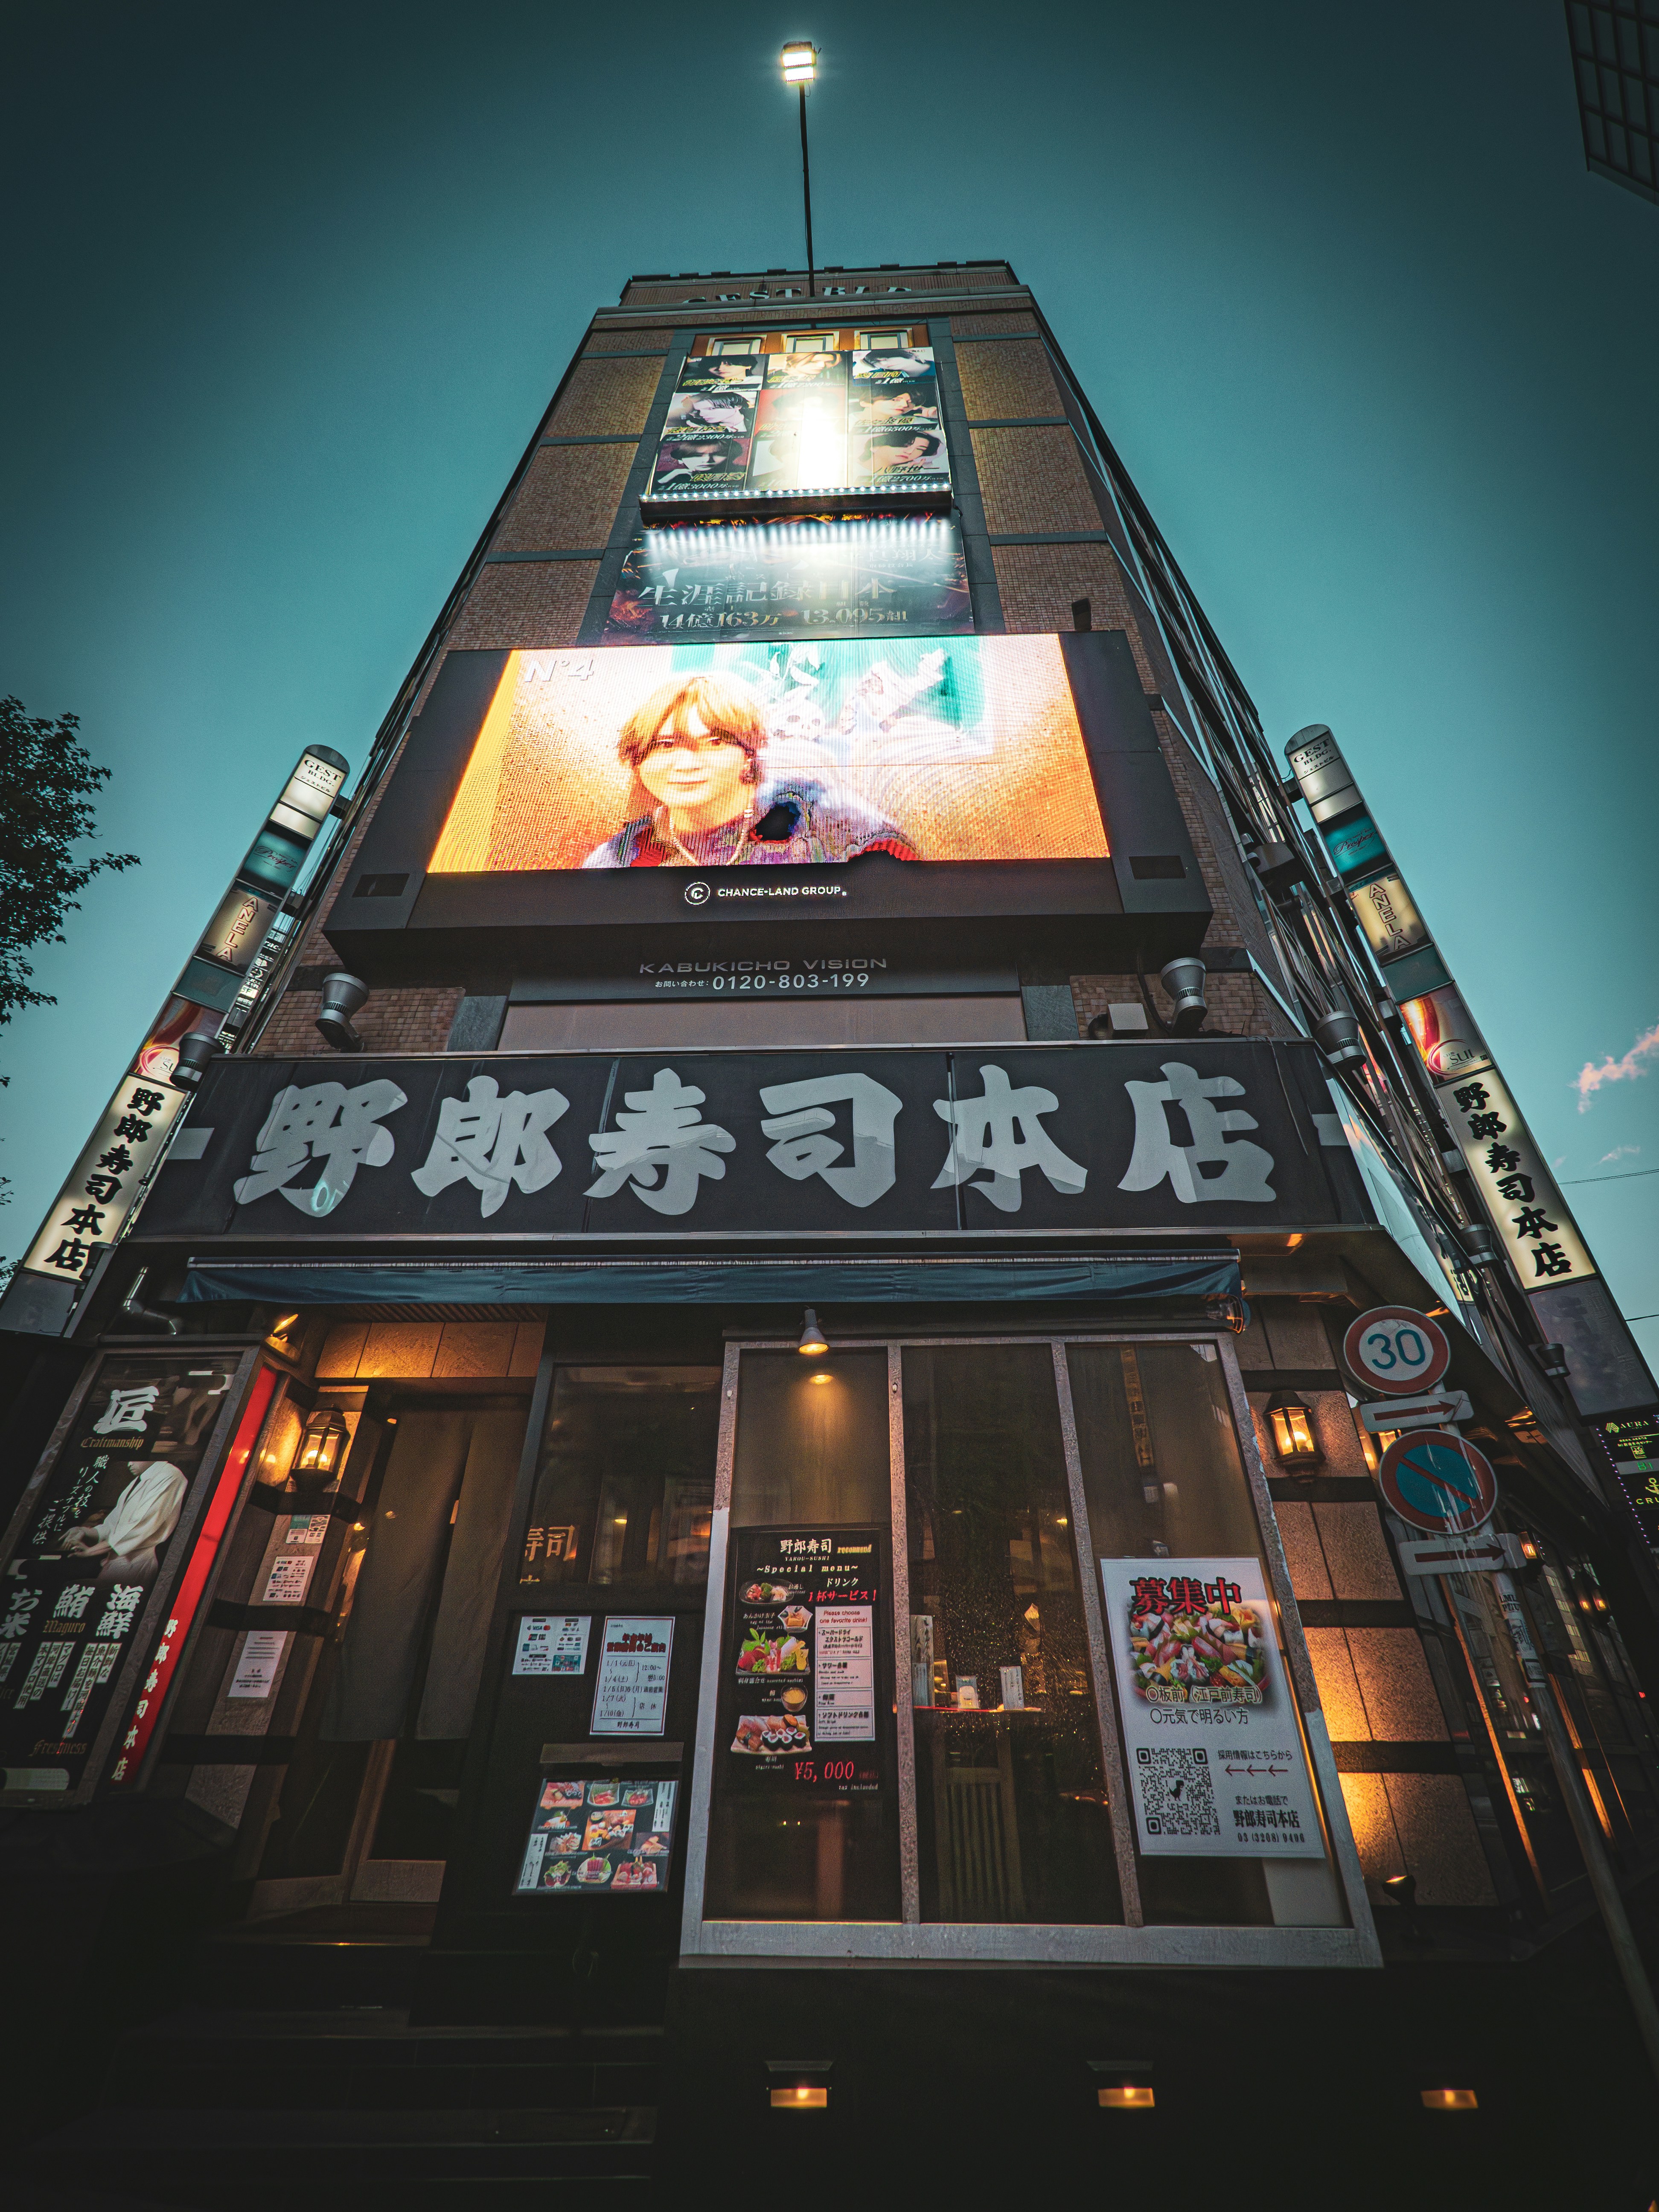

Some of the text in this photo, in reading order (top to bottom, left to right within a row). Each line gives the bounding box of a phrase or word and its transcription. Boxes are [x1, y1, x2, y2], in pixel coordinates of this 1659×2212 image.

[1294, 738, 1329, 763] GEST
[1304, 749, 1331, 765] BLDG.
[304, 759, 341, 781] GEST
[1304, 755, 1334, 774] ジェストビル
[300, 775, 331, 793] ジェストビル
[308, 769, 334, 787] BLDG.
[718, 886, 799, 897] CHANCE-LAND
[1369, 883, 1411, 951] ANELA
[215, 896, 259, 962] ANELA
[640, 958, 887, 974] KABUKICHO VISION
[713, 973, 869, 990] 0120-803-199
[160, 1060, 174, 1072] SU
[1449, 1049, 1475, 1065] SUI
[234, 1062, 1277, 1218] 野郎寿司本店
[43, 1087, 165, 1272] 野郎寿司本店
[1452, 1081, 1573, 1278] 野郎寿司本店
[1367, 1329, 1426, 1370] 30
[93, 1385, 160, 1434] 匠
[1621, 1420, 1649, 1429] AURA
[80, 1436, 144, 1450] Craftmanship
[1637, 1461, 1654, 1471] B1
[74, 1454, 110, 1518] 職人の技を
[780, 1538, 832, 1554] 野郎寿司
[827, 1577, 859, 1588] ドリンク
[52, 1584, 96, 1618] 鮪
[1129, 1576, 1242, 1616] 募集中
[0, 1588, 43, 1639] お米
[95, 1583, 144, 1639] 海鮮
[43, 1620, 86, 1636] Maguro
[50, 1644, 73, 1682] マグロは
[111, 1619, 178, 1781] 野郎寿司本店
[1218, 1749, 1292, 1761] 採用情報はこちらから
[795, 1761, 854, 1783] ¥5,000
[1235, 1795, 1288, 1806] またはお電話で
[1233, 1808, 1301, 1828] 野郎寿司本店
